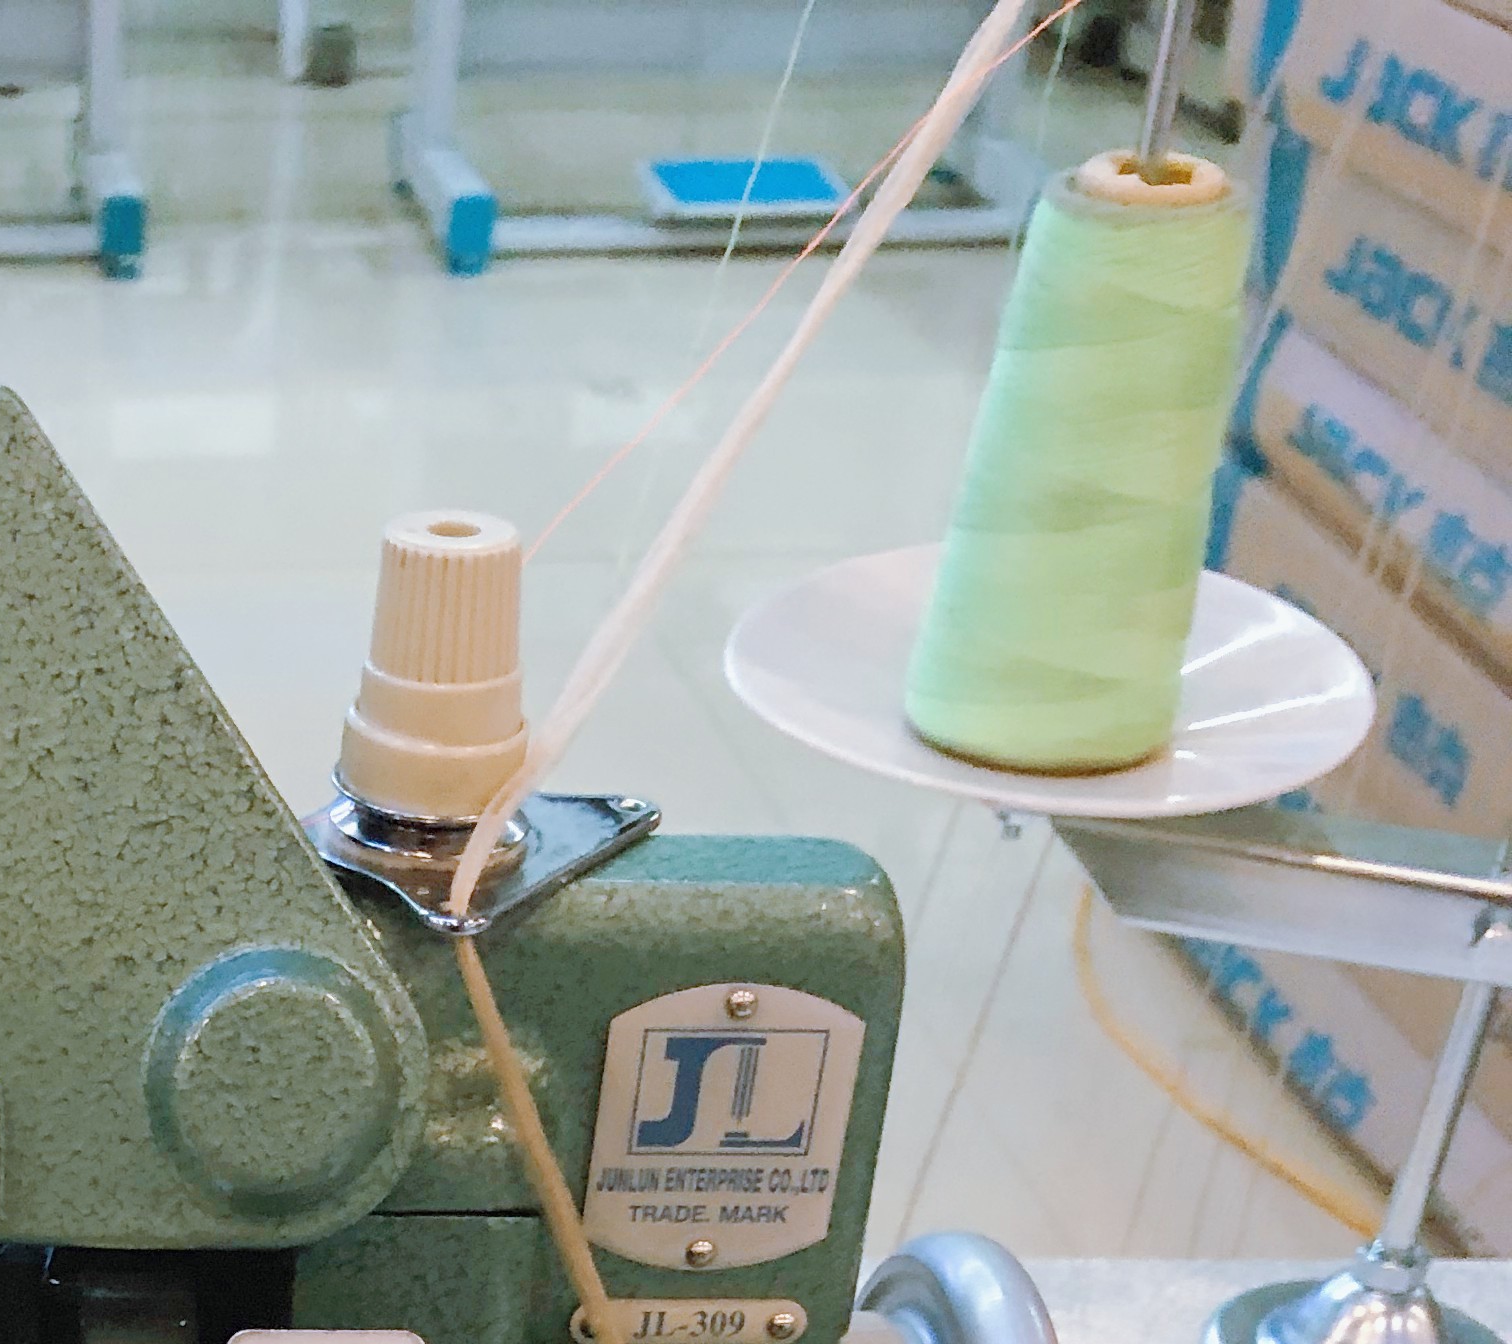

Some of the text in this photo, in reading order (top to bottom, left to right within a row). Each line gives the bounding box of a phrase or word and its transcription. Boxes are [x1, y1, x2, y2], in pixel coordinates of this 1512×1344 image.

[664, 1167, 764, 1193] ENTERPRISE
[628, 1205, 788, 1223] TRADE MARK
[633, 1310, 746, 1339] JL-309
